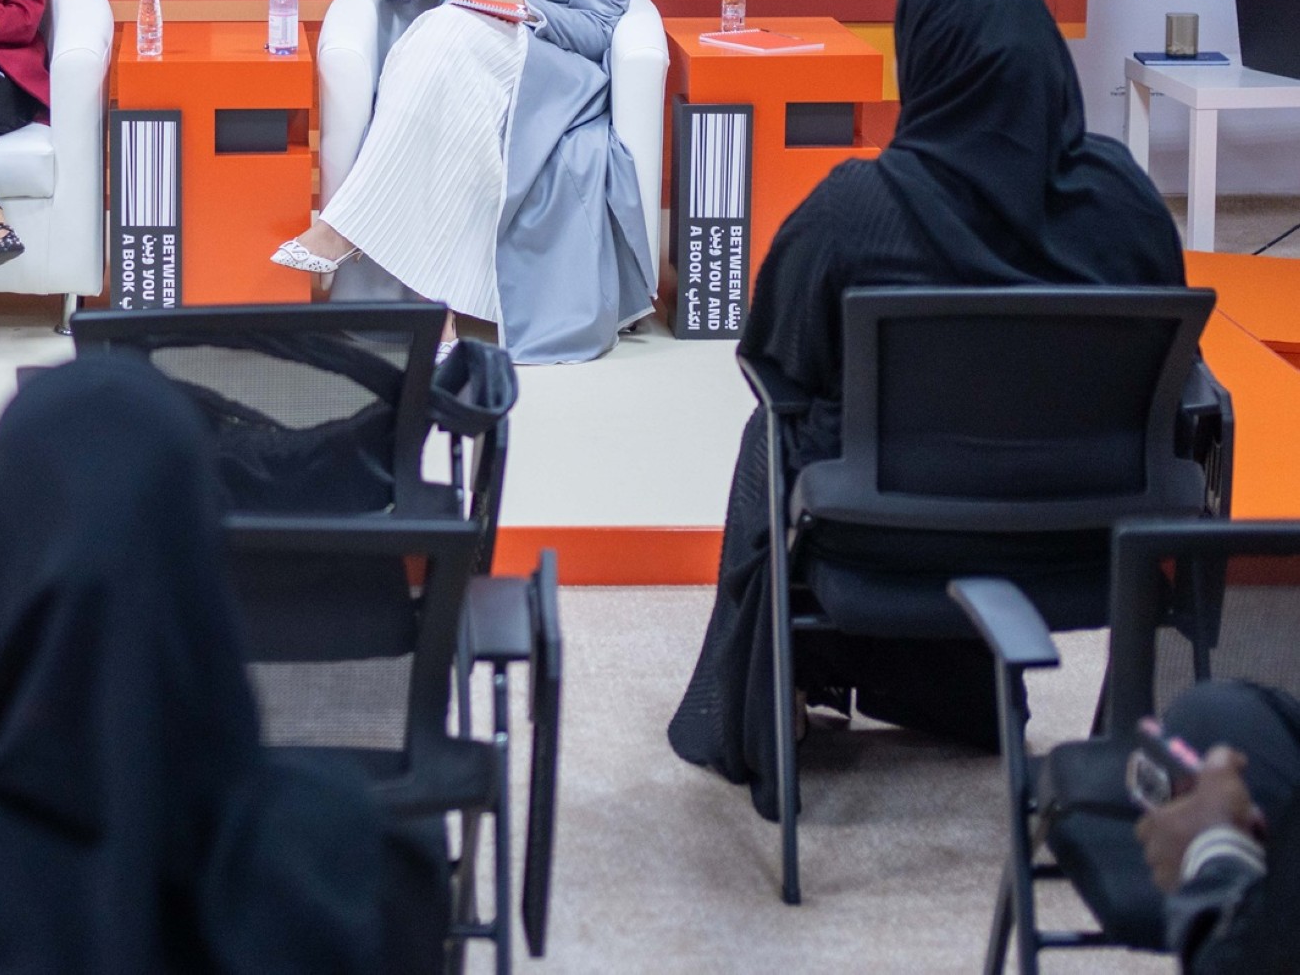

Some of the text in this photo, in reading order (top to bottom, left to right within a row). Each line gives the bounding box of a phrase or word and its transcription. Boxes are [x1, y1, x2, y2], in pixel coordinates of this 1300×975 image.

[122, 233, 135, 245] A
[689, 225, 702, 283] A BOOK
[729, 225, 743, 300] BETWEEN
[122, 249, 135, 292] BOOK
[142, 269, 155, 301] YOU
[163, 234, 175, 309] BETWEEN
[708, 261, 722, 331] YOU AND
